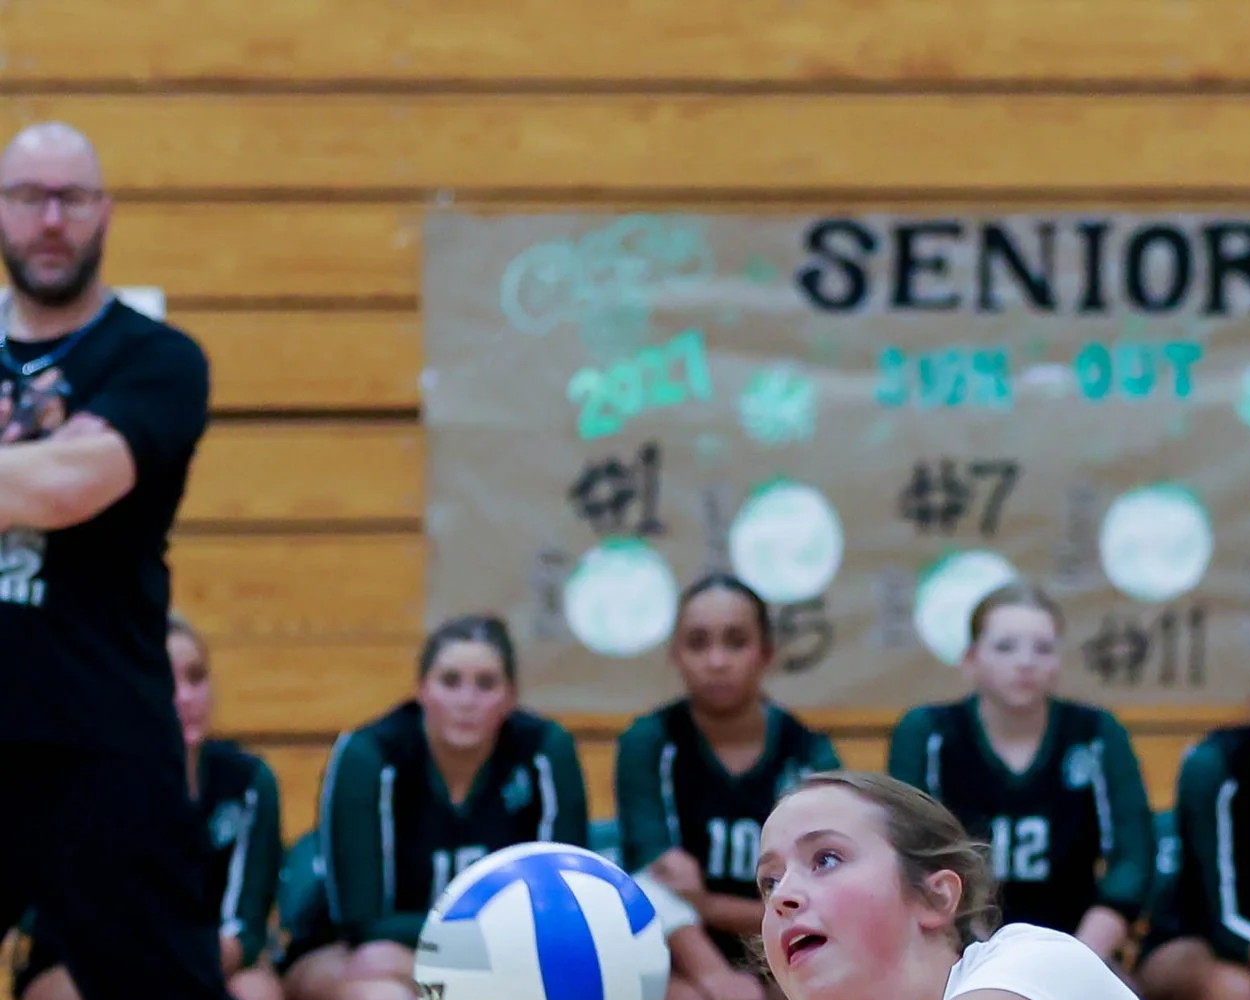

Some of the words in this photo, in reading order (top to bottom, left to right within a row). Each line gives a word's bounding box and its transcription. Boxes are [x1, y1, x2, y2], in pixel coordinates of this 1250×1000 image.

[1072, 340, 1203, 401] OUT
[897, 455, 1022, 537] #7
[1079, 605, 1208, 686] #11
[708, 816, 760, 880] 10
[992, 815, 1051, 882] 12
